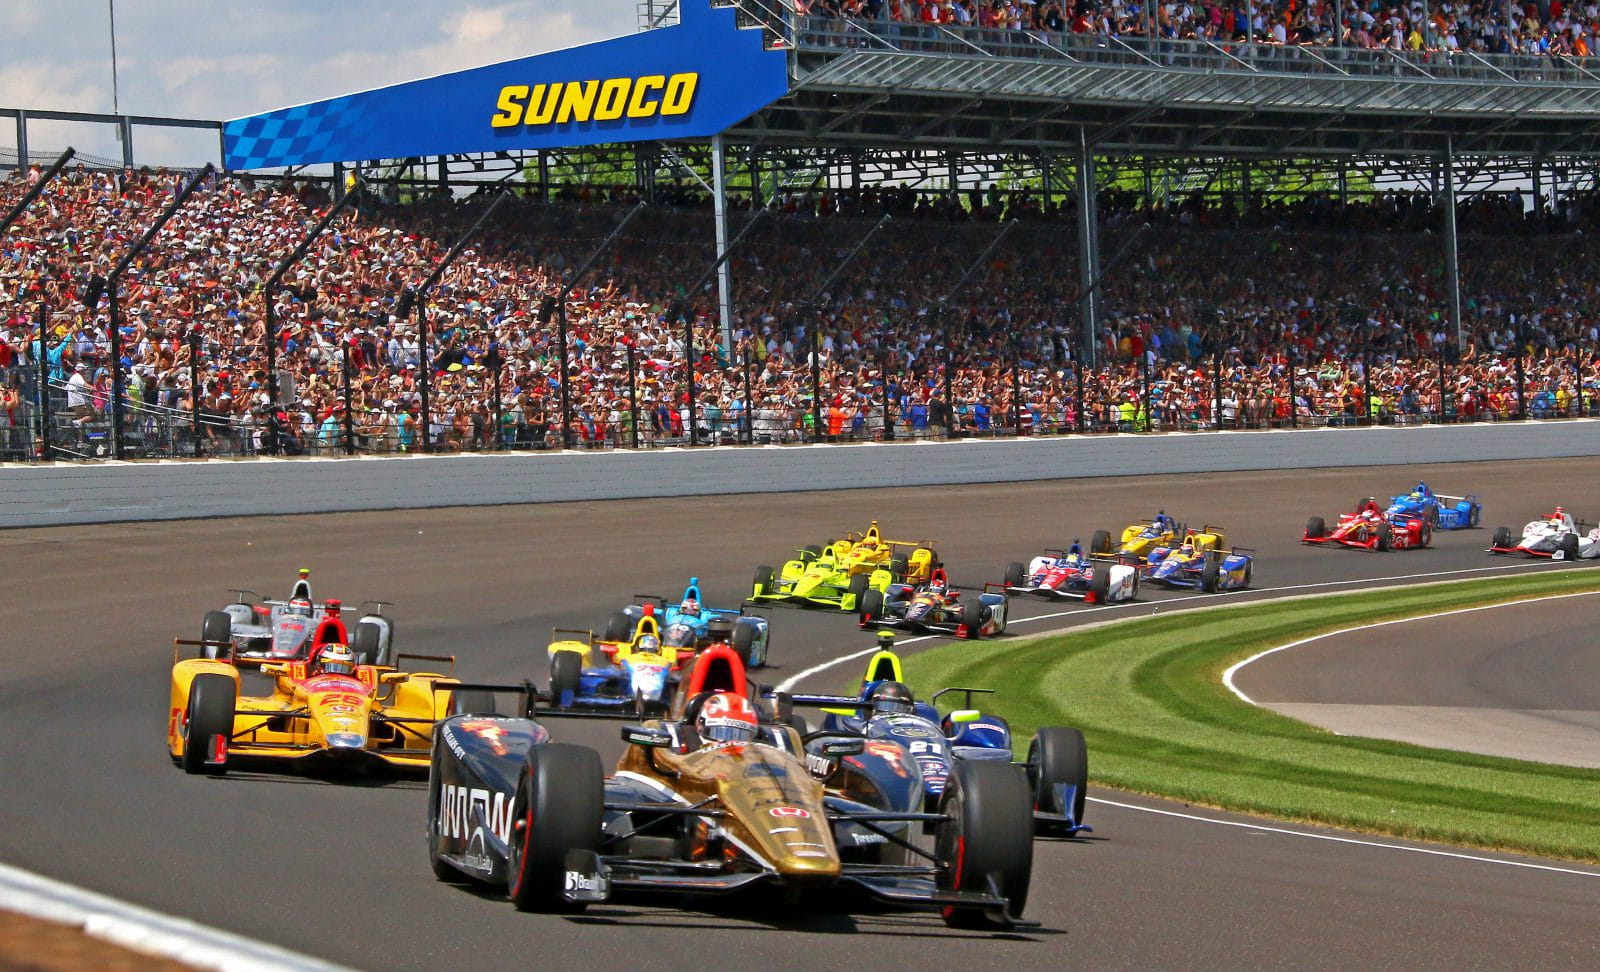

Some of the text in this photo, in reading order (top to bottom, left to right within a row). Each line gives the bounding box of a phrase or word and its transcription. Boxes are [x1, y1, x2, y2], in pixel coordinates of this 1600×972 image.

[490, 72, 699, 128] SUNOCO
[320, 694, 363, 706] 26
[909, 741, 942, 754] 21
